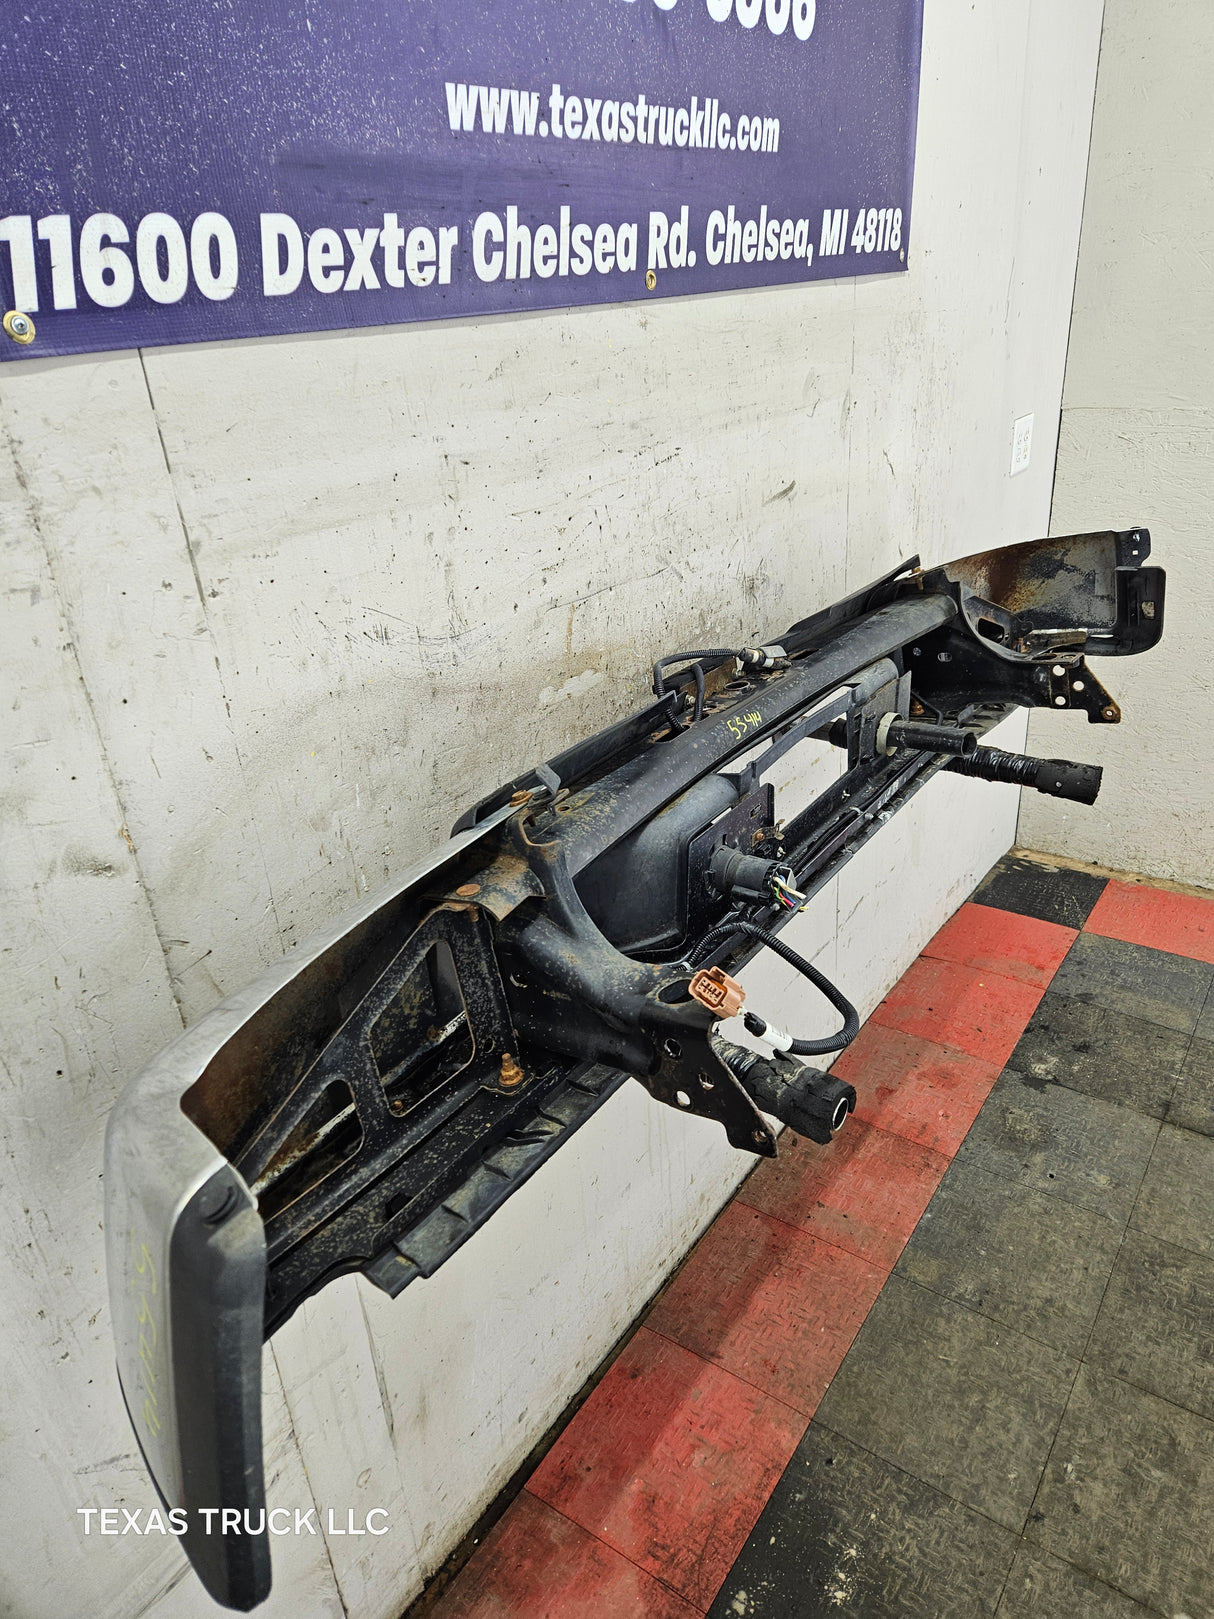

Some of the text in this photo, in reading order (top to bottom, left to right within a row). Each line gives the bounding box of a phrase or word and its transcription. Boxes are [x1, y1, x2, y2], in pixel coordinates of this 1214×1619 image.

[444, 82, 780, 153] www.texastruckllc.com
[0, 204, 903, 312] 11600 Dexter Chelsea Rd. Chelsea, MI 48118
